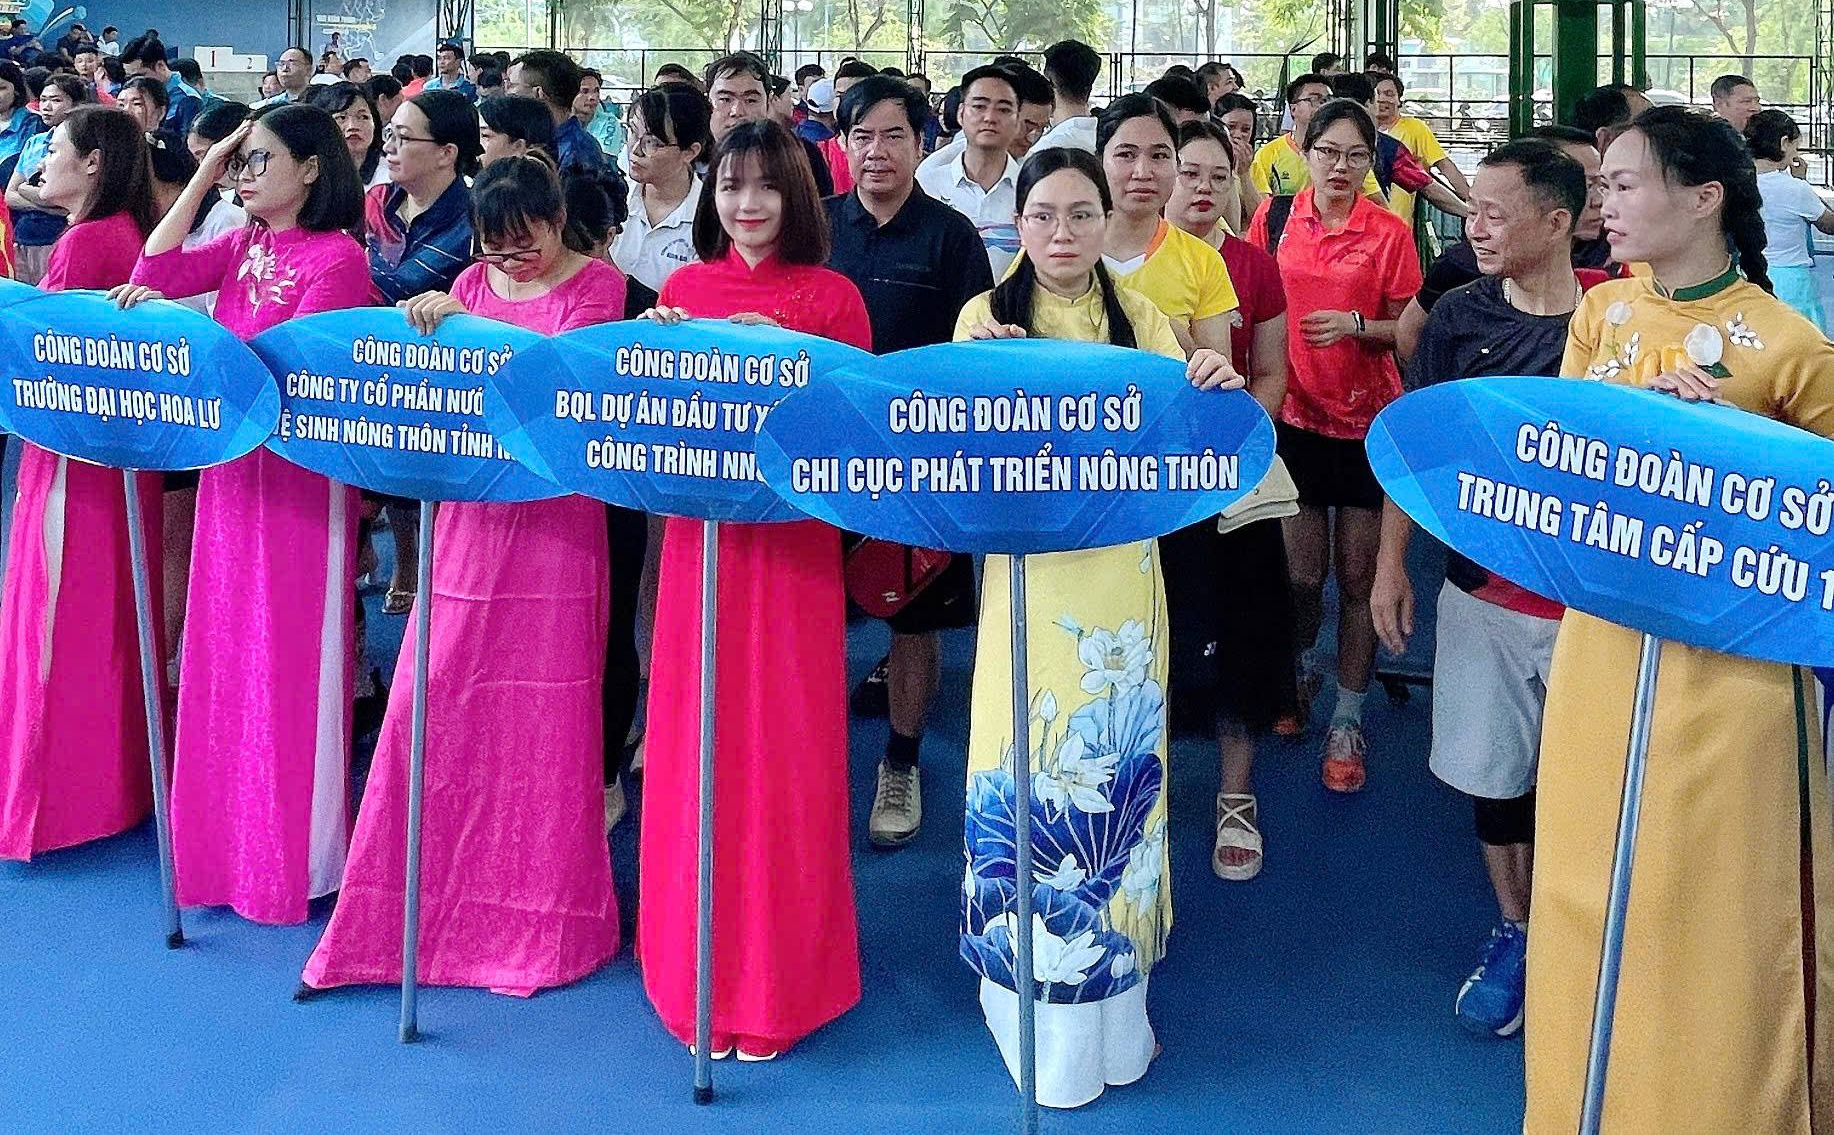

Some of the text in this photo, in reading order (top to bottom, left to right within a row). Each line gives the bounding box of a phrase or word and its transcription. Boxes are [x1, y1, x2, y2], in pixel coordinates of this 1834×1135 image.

[210, 50, 216, 68] 1
[247, 57, 253, 70] 2
[34, 329, 191, 376] CÔNG ĐOÀN CƠ SỞ
[353, 335, 400, 367] CÔNG
[405, 341, 455, 372] ĐOÀN
[460, 348, 484, 374] CƠ
[616, 343, 809, 387] CÔNG ĐOÀN CƠ SỞ
[12, 375, 221, 430] TRƯỜNG ĐẠI HỌC HOA LƯ
[286, 369, 334, 401] CÔNG
[338, 378, 359, 403] TY
[363, 373, 389, 407] CỔ
[391, 377, 442, 412] PHẦN
[556, 390, 596, 422] BQL
[601, 394, 634, 429] DỰ
[635, 390, 667, 425] ÁN
[672, 391, 717, 430] ĐẦU
[722, 401, 752, 433] TƯ
[889, 385, 1142, 433] CÔNG ĐOÀN CƠ SỞ
[273, 408, 292, 442] Ệ
[295, 414, 339, 442] SINH
[343, 415, 394, 449] NÔNG
[398, 422, 446, 454] THÔN
[450, 422, 493, 458] TỈNH
[587, 435, 765, 482] CÔNG TRÌNH NN
[792, 442, 1239, 499] CHI CỤC PHÁT TRIỂN NÔNG THÔN
[1516, 422, 1834, 535] CÔNG ĐOÀN CƠ SỞ
[1458, 472, 1561, 536] TRUNG
[1570, 501, 1643, 558] TÂM
[1650, 520, 1724, 578] CẤP
[1732, 545, 1809, 602] CỨU
